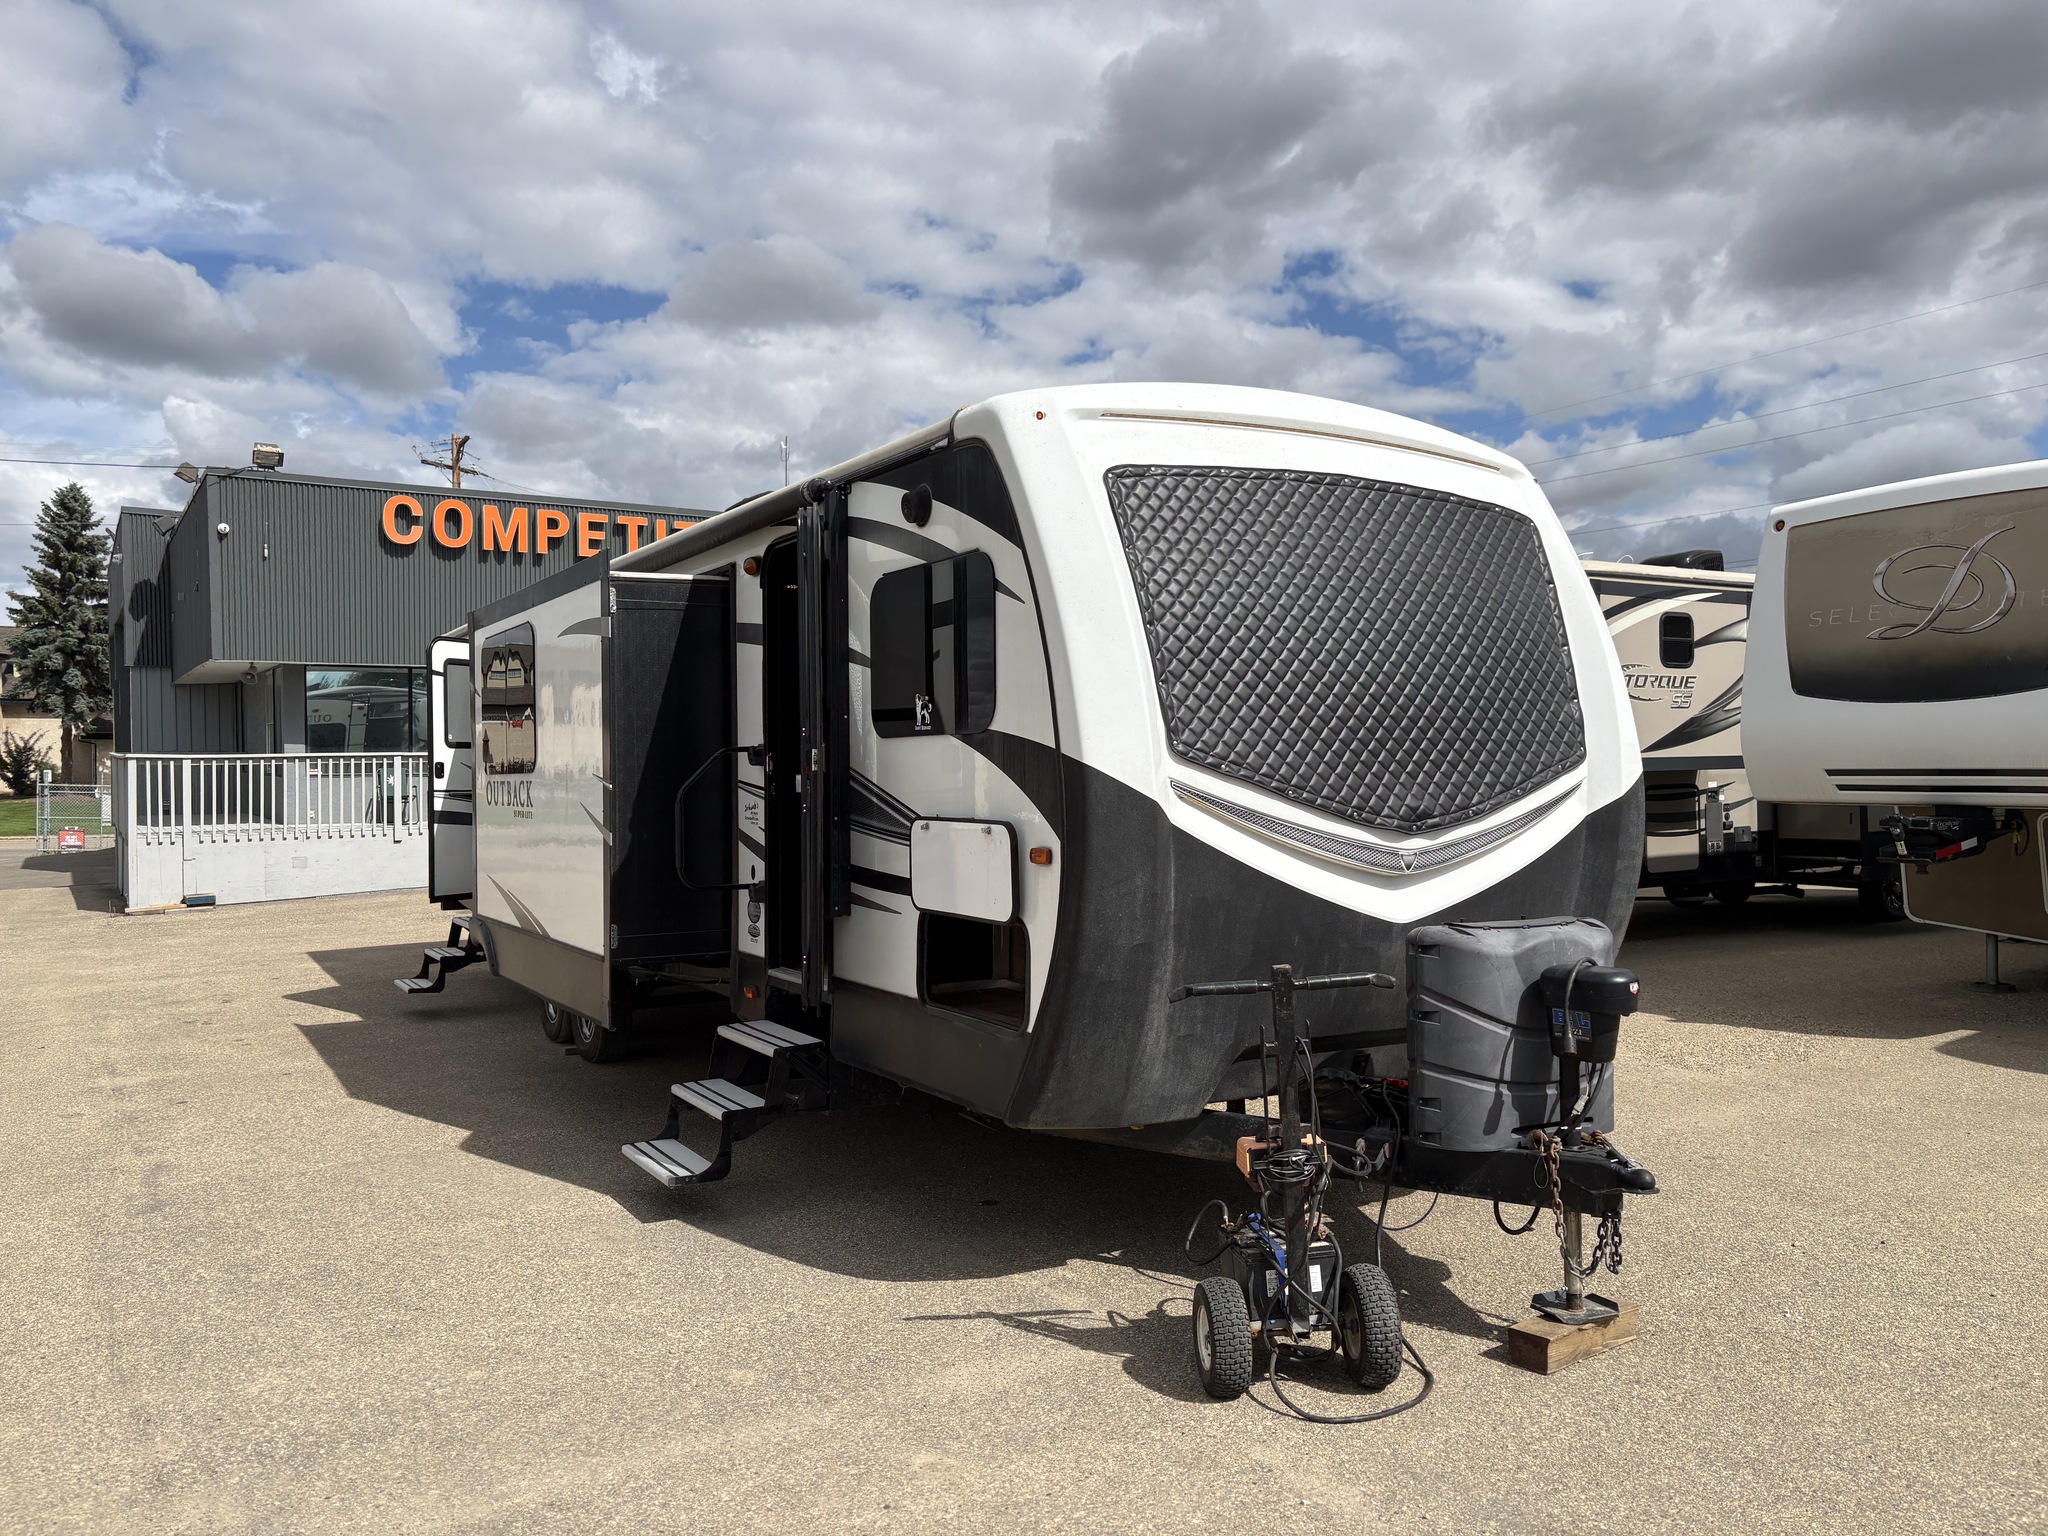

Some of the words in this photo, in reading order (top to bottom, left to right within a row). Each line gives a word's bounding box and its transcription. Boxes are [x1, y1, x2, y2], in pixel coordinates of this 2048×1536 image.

[382, 494, 699, 558] COMPETI
[1623, 674, 1698, 690] TORQUE
[1670, 692, 1693, 710] SS
[486, 780, 533, 808] OUTBACK
